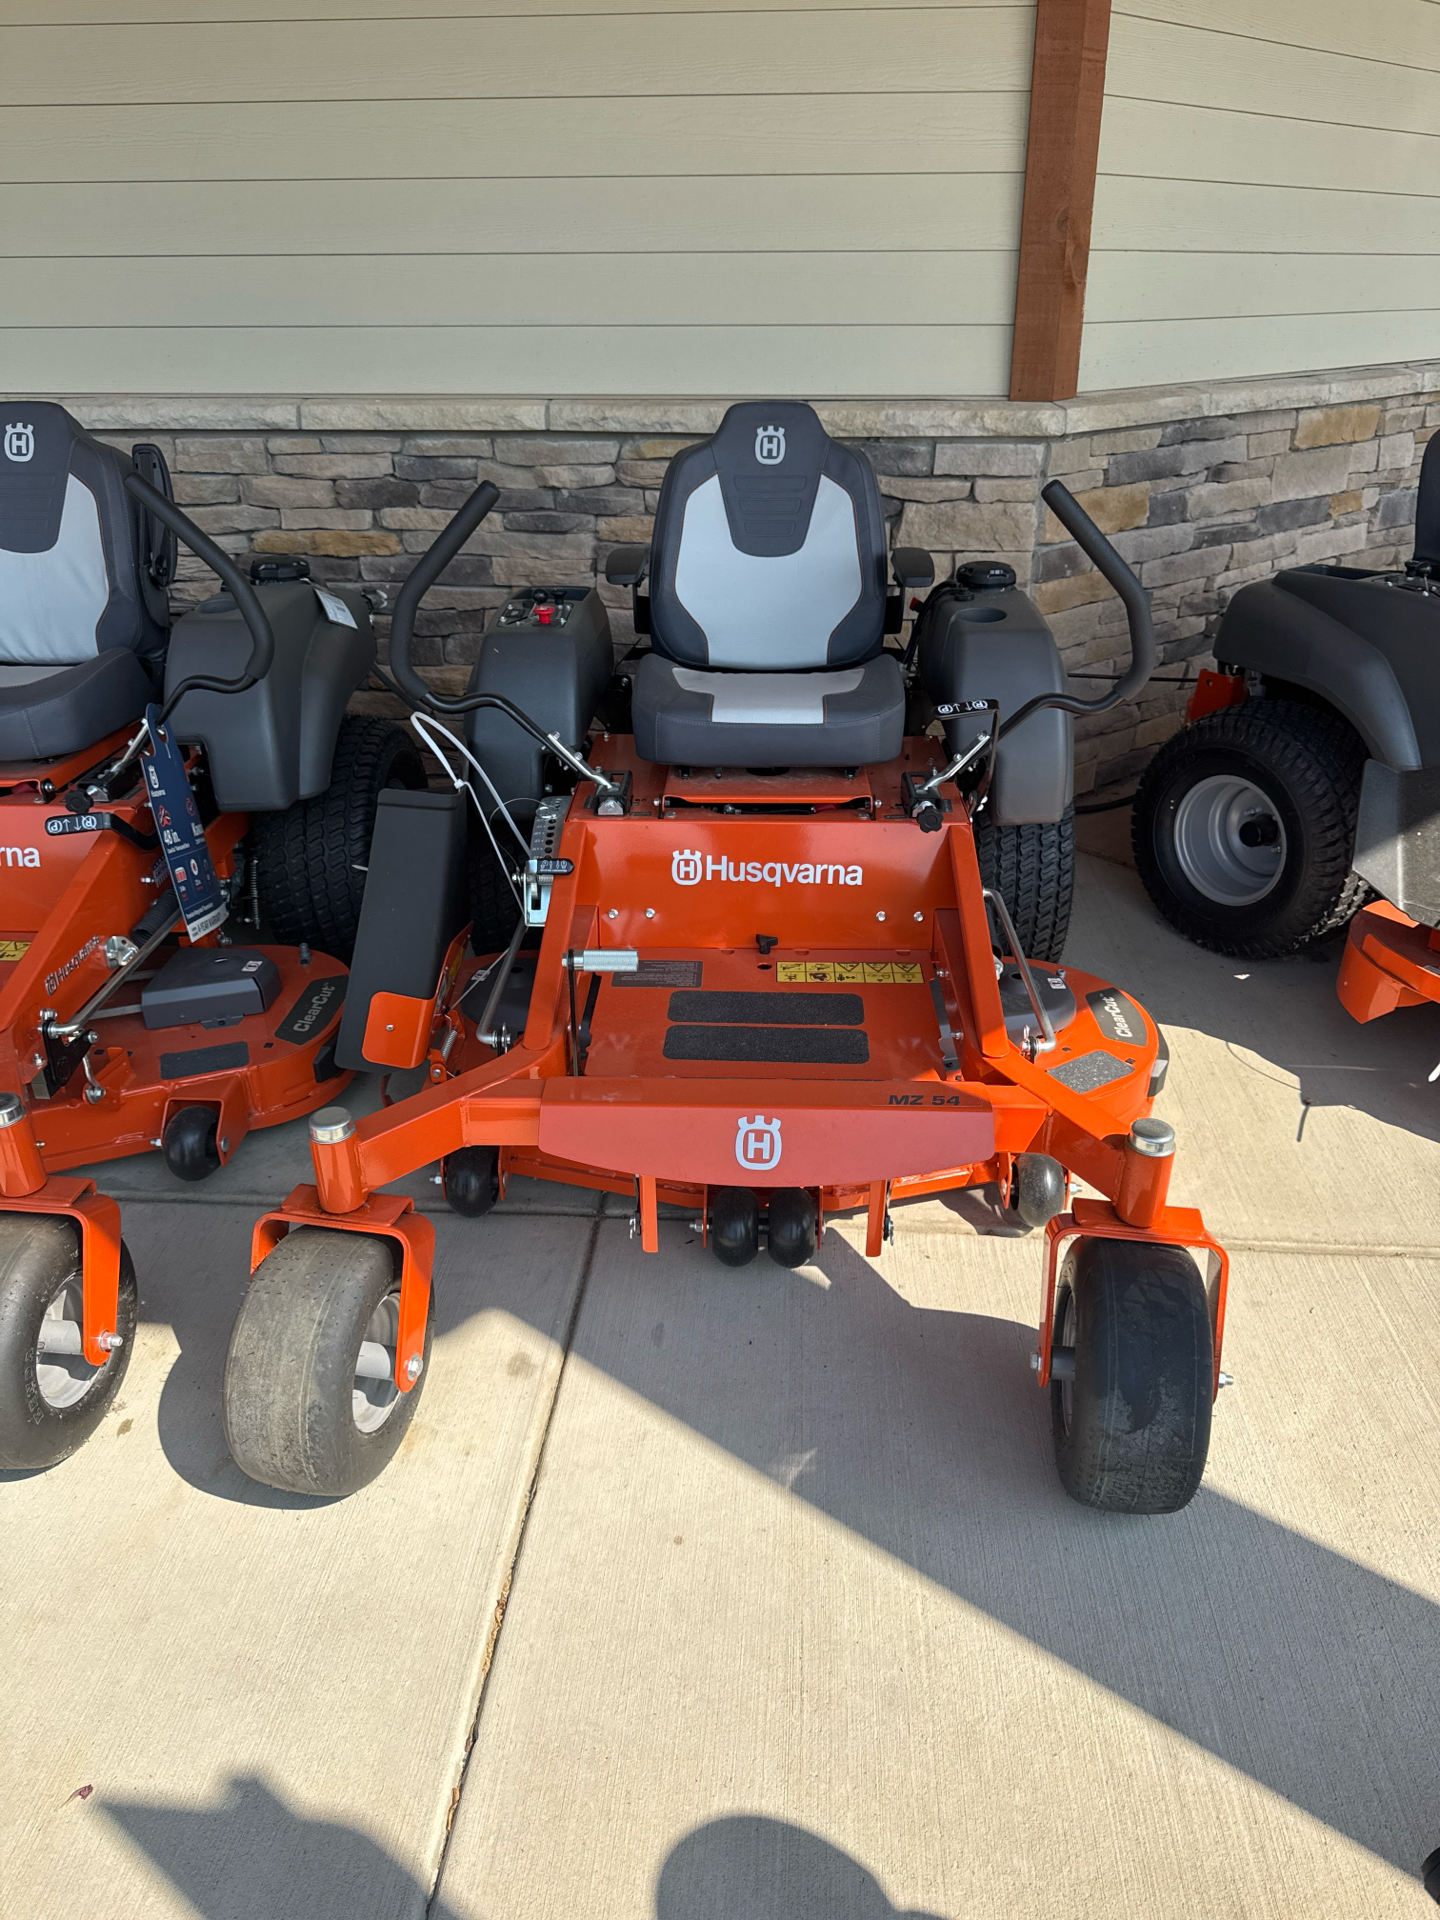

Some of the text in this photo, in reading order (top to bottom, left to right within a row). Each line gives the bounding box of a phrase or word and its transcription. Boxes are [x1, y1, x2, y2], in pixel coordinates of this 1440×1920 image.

[706, 854, 863, 887] Husqvarna
[54, 933, 100, 986] Husqvarna
[293, 986, 336, 1032] ClearCut
[1102, 996, 1133, 1038] ClearCut
[888, 1094, 960, 1106] MZ 54
